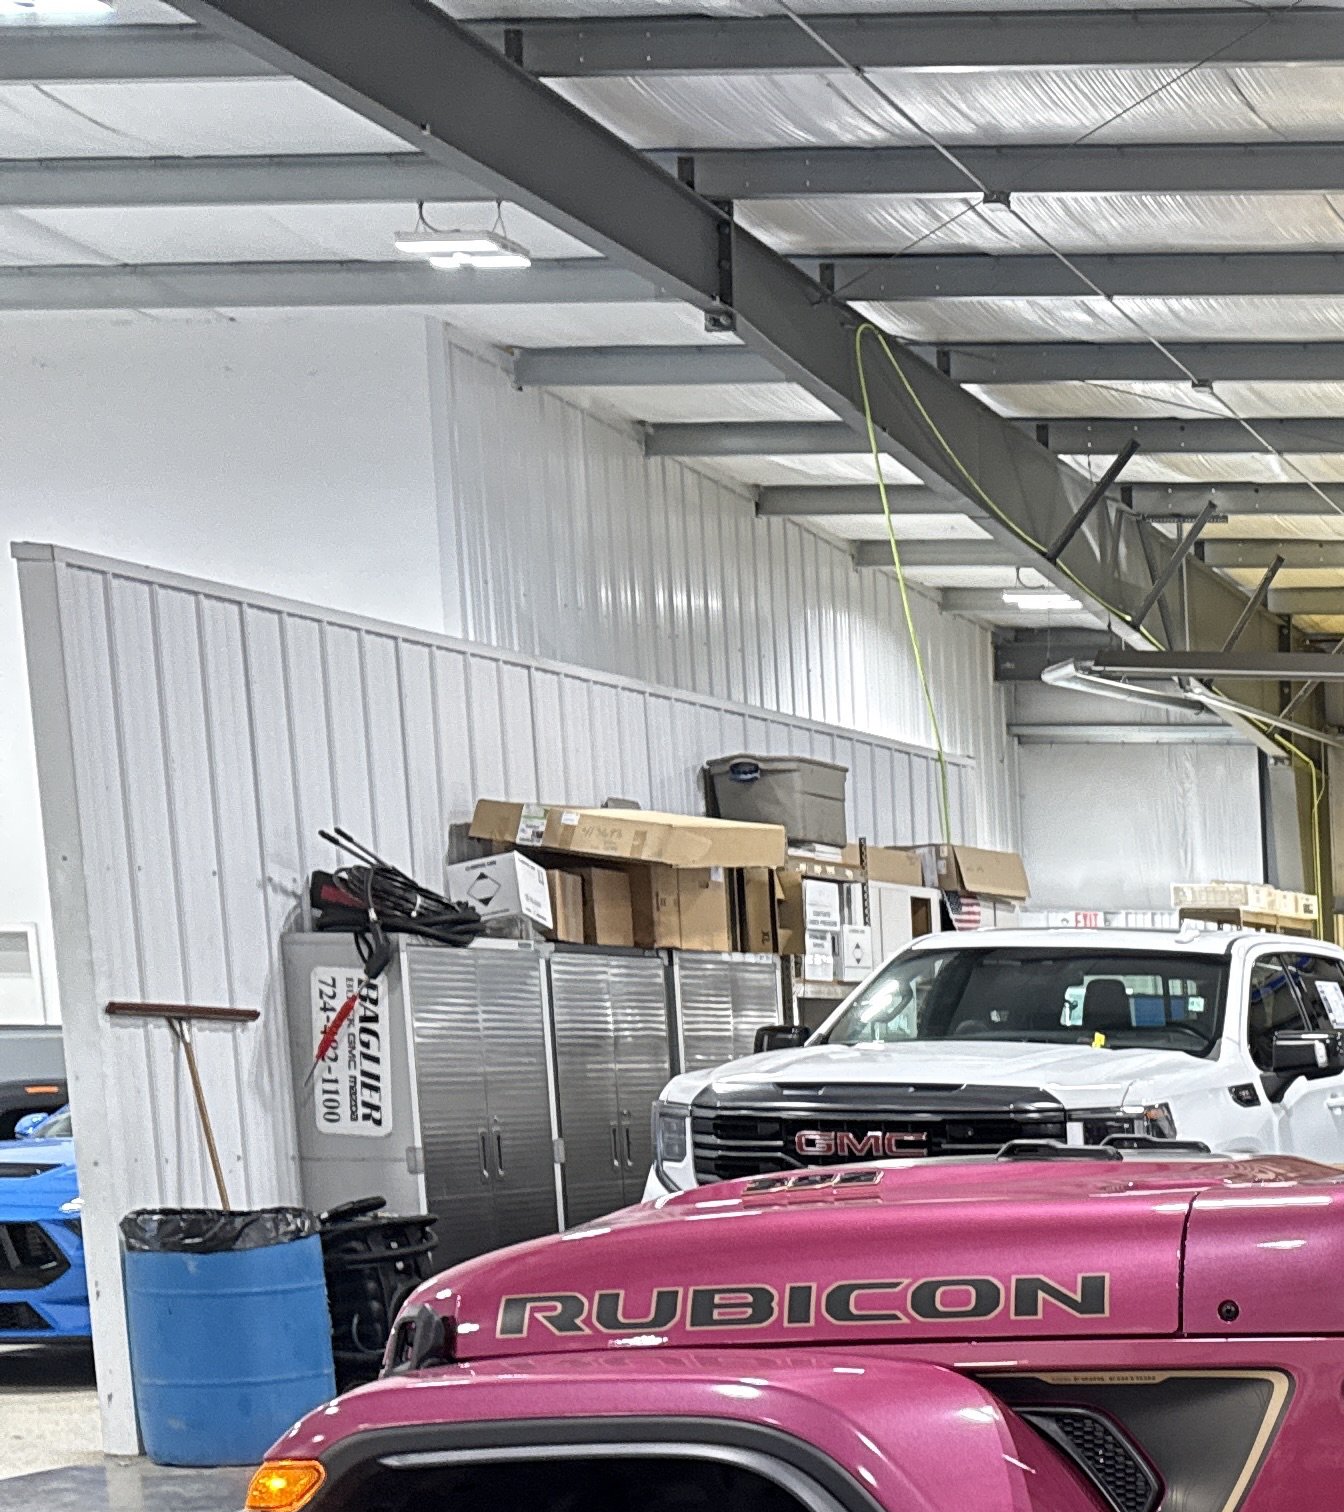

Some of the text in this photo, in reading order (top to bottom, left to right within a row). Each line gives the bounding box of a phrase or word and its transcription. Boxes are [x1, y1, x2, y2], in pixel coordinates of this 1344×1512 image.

[1074, 911, 1099, 928] EXIT
[357, 976, 382, 1128] BAGLIER
[795, 1130, 928, 1157] GMC
[496, 1272, 1110, 1339] RUBICON
